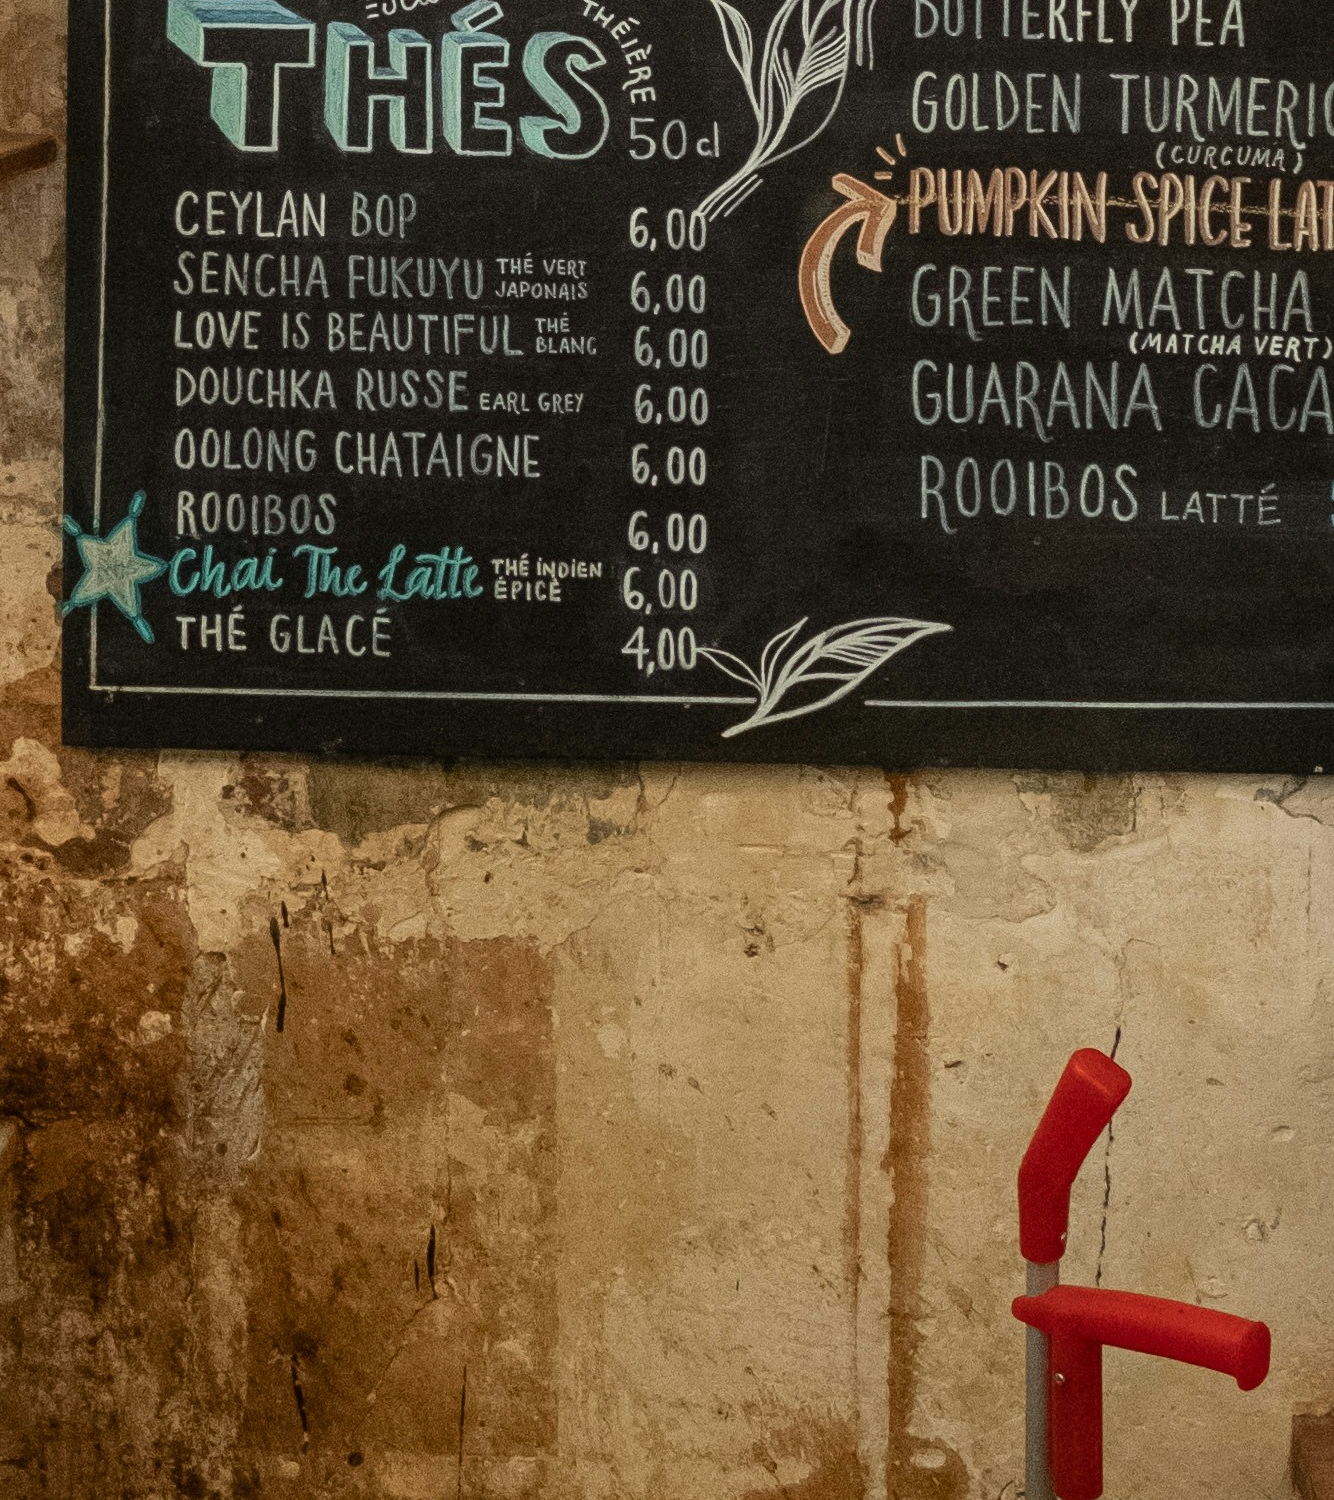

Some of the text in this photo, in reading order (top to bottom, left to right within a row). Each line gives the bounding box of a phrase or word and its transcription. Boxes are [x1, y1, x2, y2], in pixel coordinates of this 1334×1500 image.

[167, 0, 609, 161] THÉS
[912, 71, 1080, 134] GOLDEN
[175, 190, 416, 239] CEYLAN BOP
[909, 167, 1108, 242] PUMPKIN
[1126, 172, 1251, 248] SPICE
[174, 252, 483, 300] SENCHA FUKUYU
[495, 281, 588, 300] JAPONAIS
[496, 254, 586, 279] THÉ VERT
[535, 312, 569, 333] THÉ
[912, 264, 1313, 340] GREEN MATCHA
[175, 310, 524, 356] LOVE IS BEAUTIFUL
[175, 367, 584, 416] DOUCHKA RUSSE EARL GREY
[912, 360, 1161, 443] GUARANA
[175, 428, 541, 478] OOLONG CHATAIGNE
[176, 491, 337, 538] ROOIBOS
[920, 455, 1281, 534] ROOIBOS LATTÉ
[168, 545, 283, 598] Chai
[379, 544, 483, 600] Latte
[176, 606, 392, 658] THÉ GLACÉ
